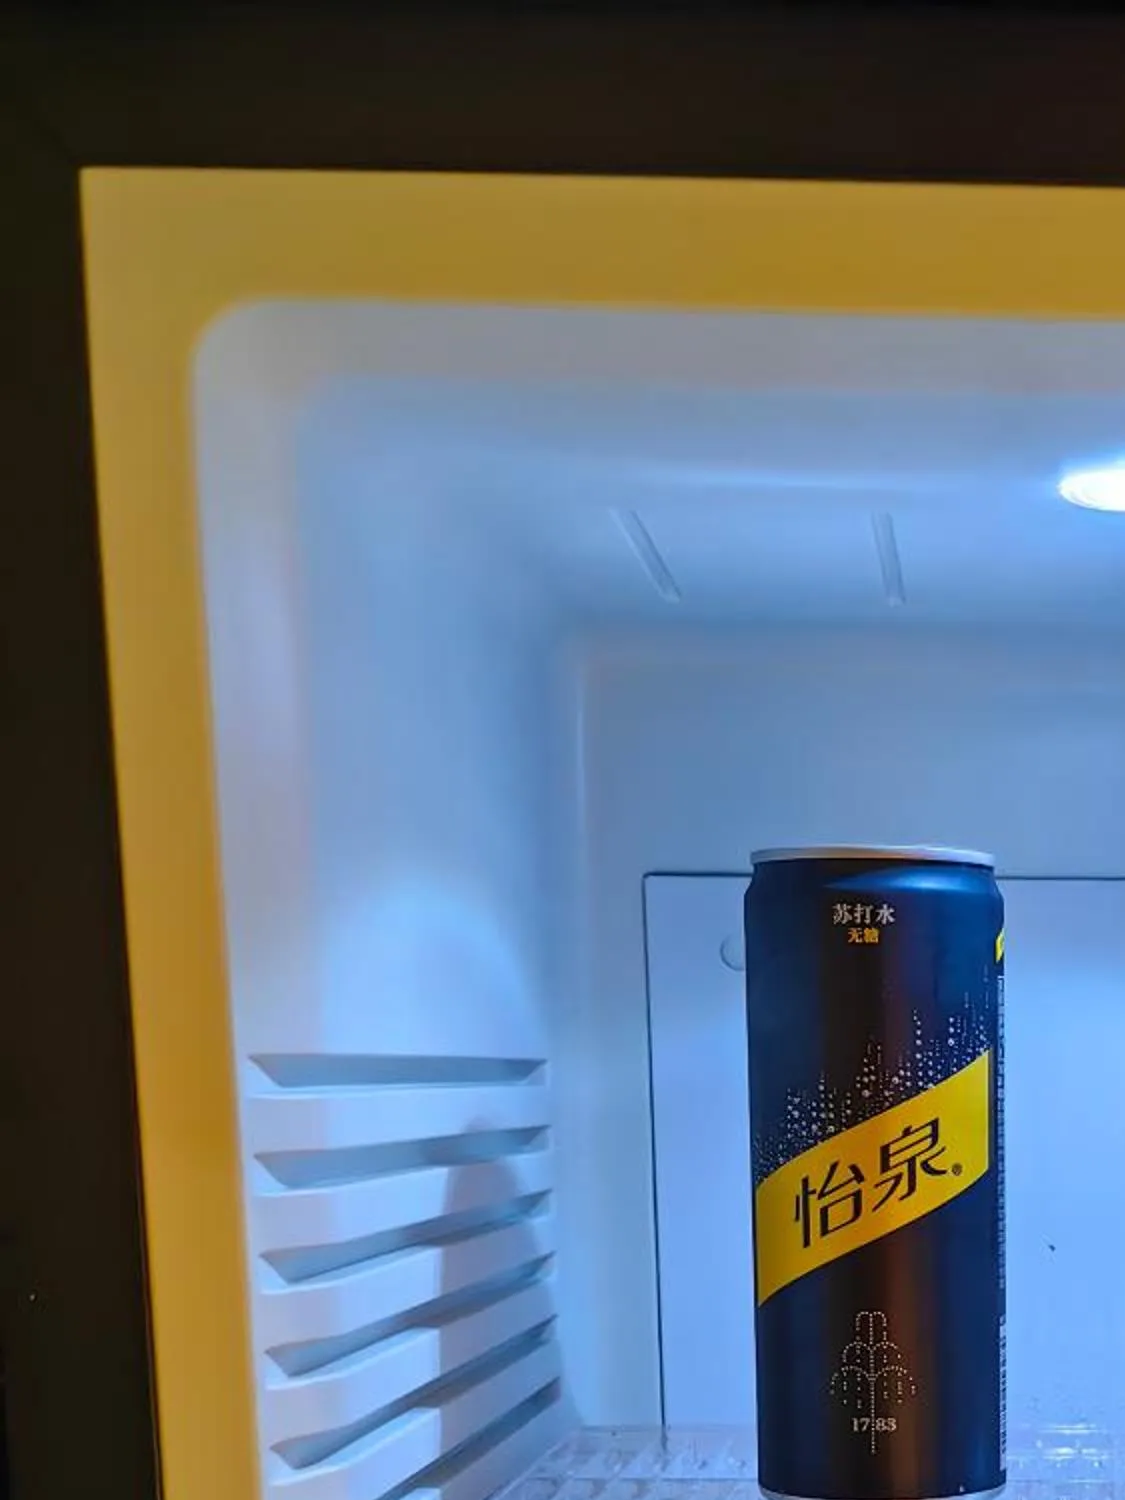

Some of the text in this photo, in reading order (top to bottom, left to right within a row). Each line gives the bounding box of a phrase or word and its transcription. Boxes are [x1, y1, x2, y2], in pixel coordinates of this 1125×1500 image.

[832, 903, 896, 925] 苏打水
[847, 927, 880, 943] 无糖
[793, 1117, 947, 1248] 怡泉
